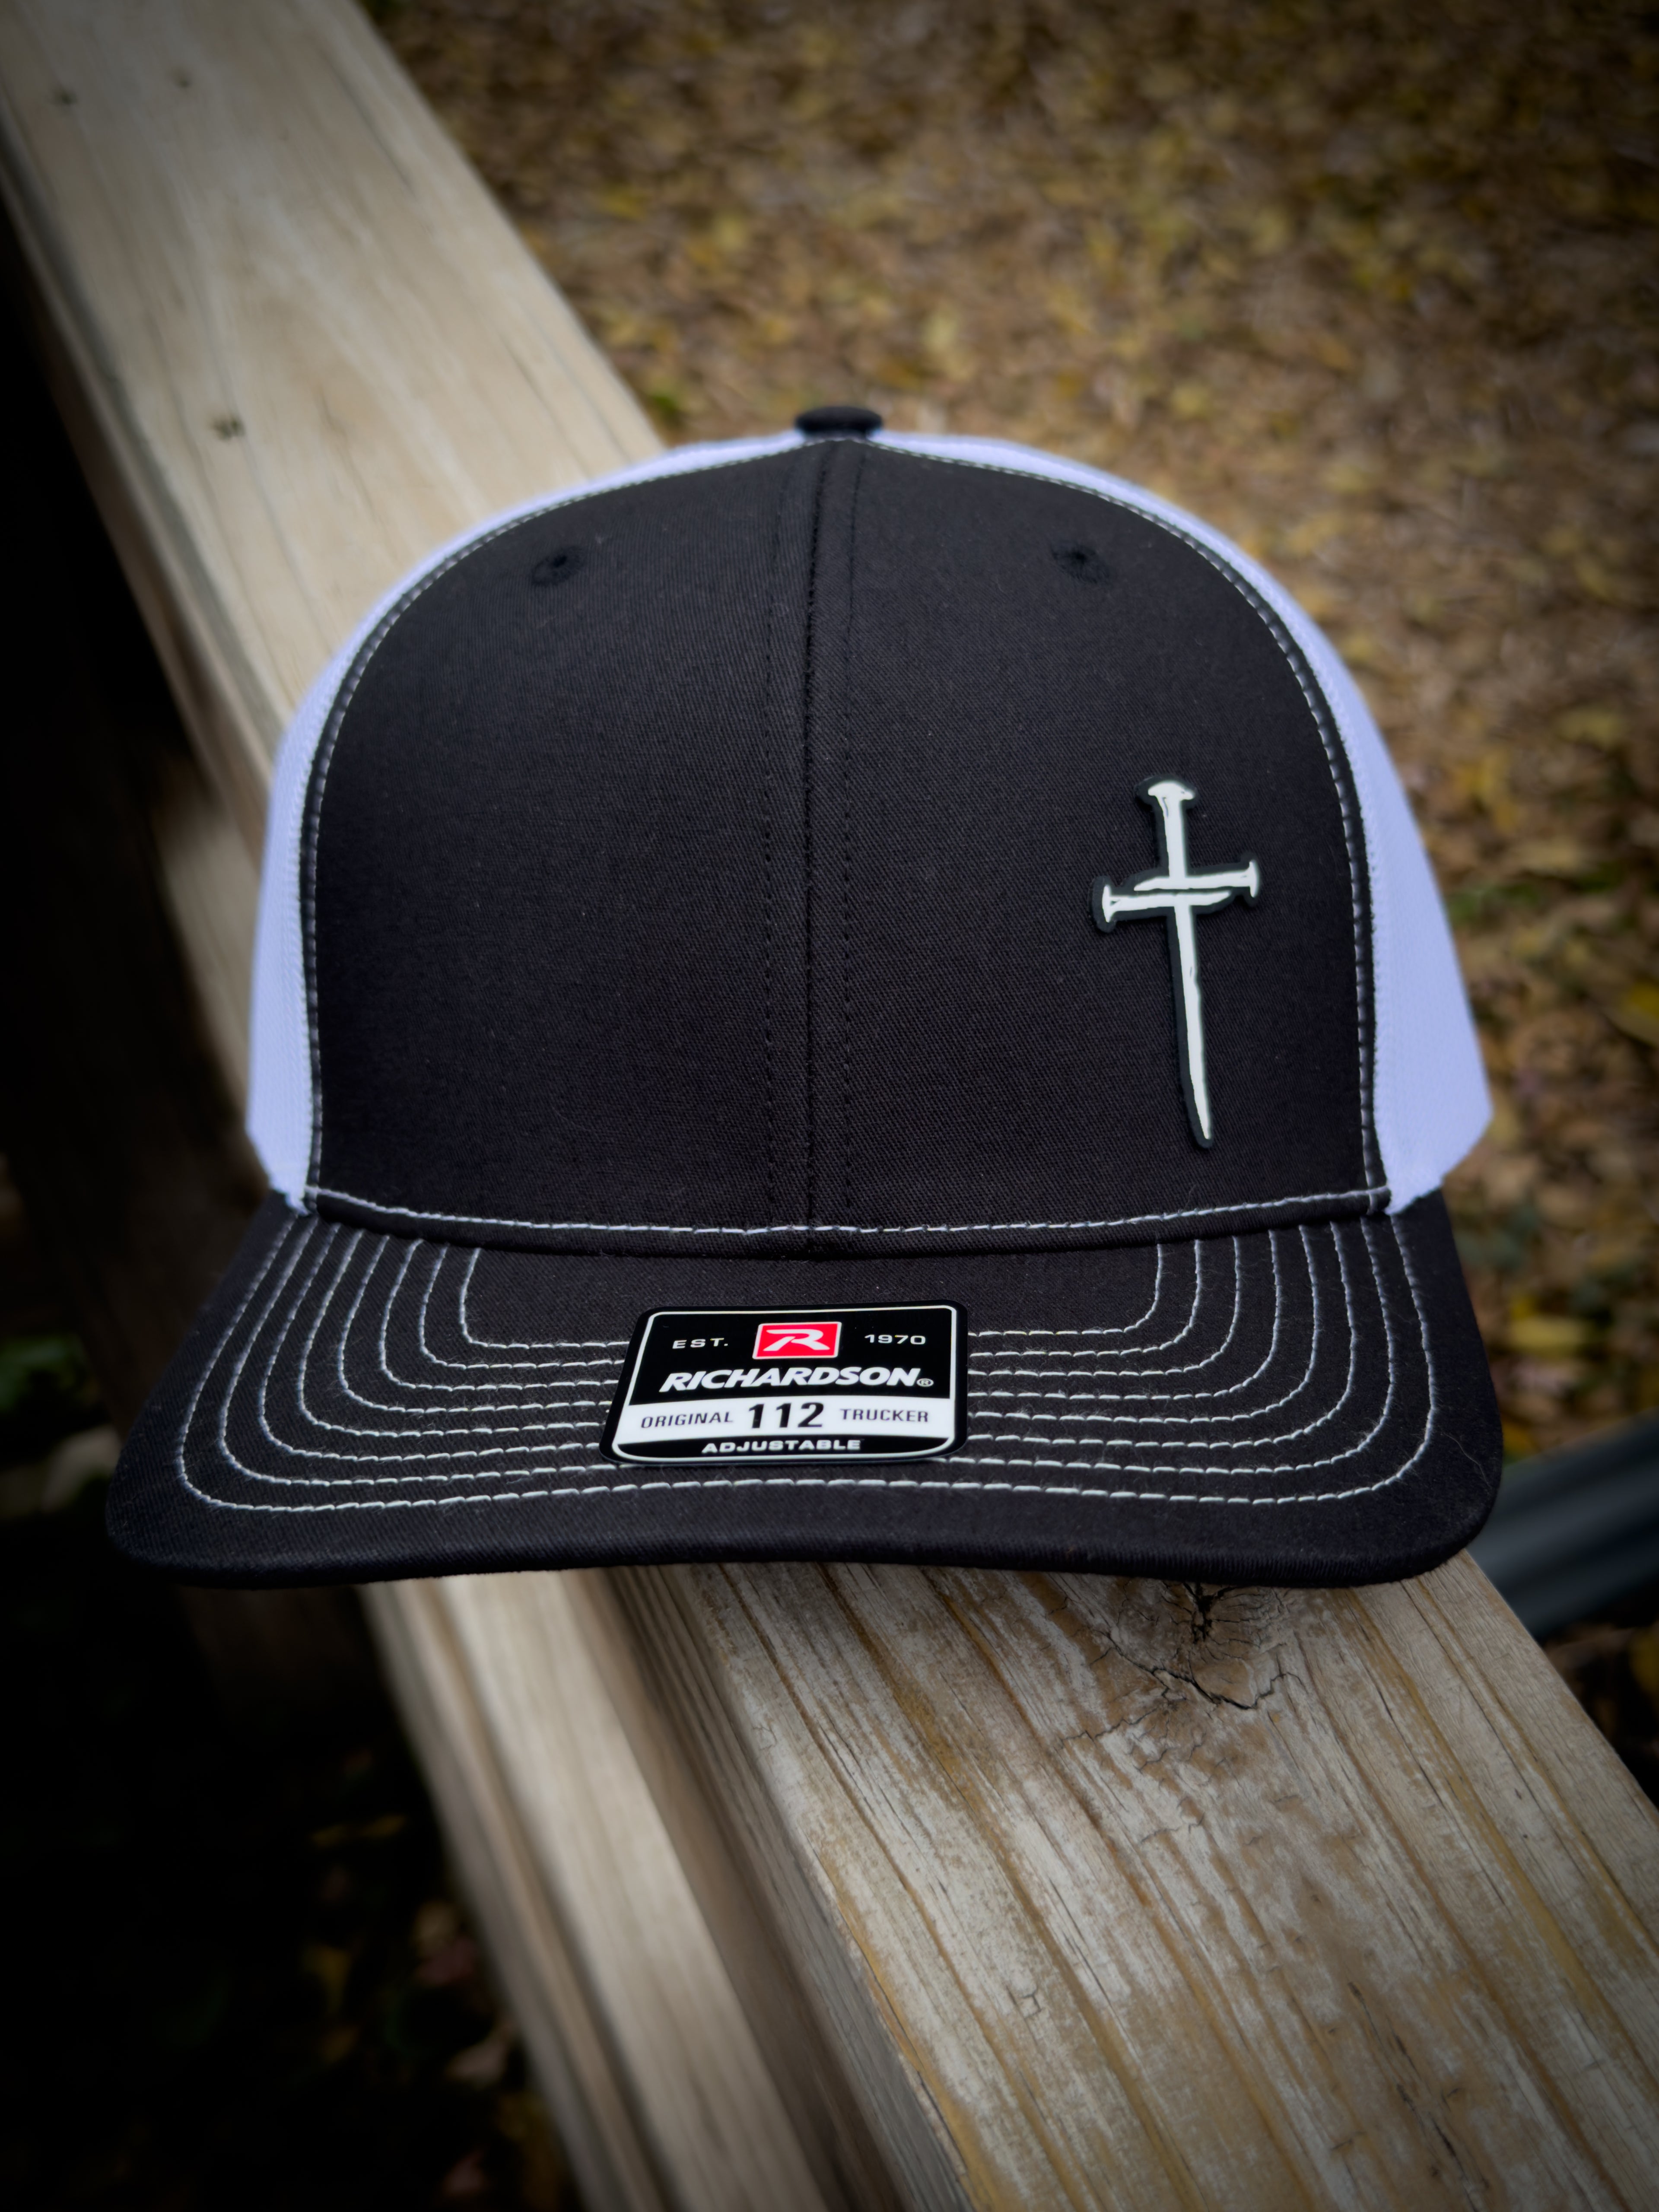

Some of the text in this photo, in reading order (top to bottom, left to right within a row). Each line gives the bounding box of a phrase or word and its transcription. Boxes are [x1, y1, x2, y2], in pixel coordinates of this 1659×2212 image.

[672, 1334, 926, 1349] EST. 1970
[763, 1328, 826, 1352] R
[641, 1402, 928, 1429] ORIGINAL 112 TRUCKER
[701, 1440, 861, 1453] ADJUSTABLE
